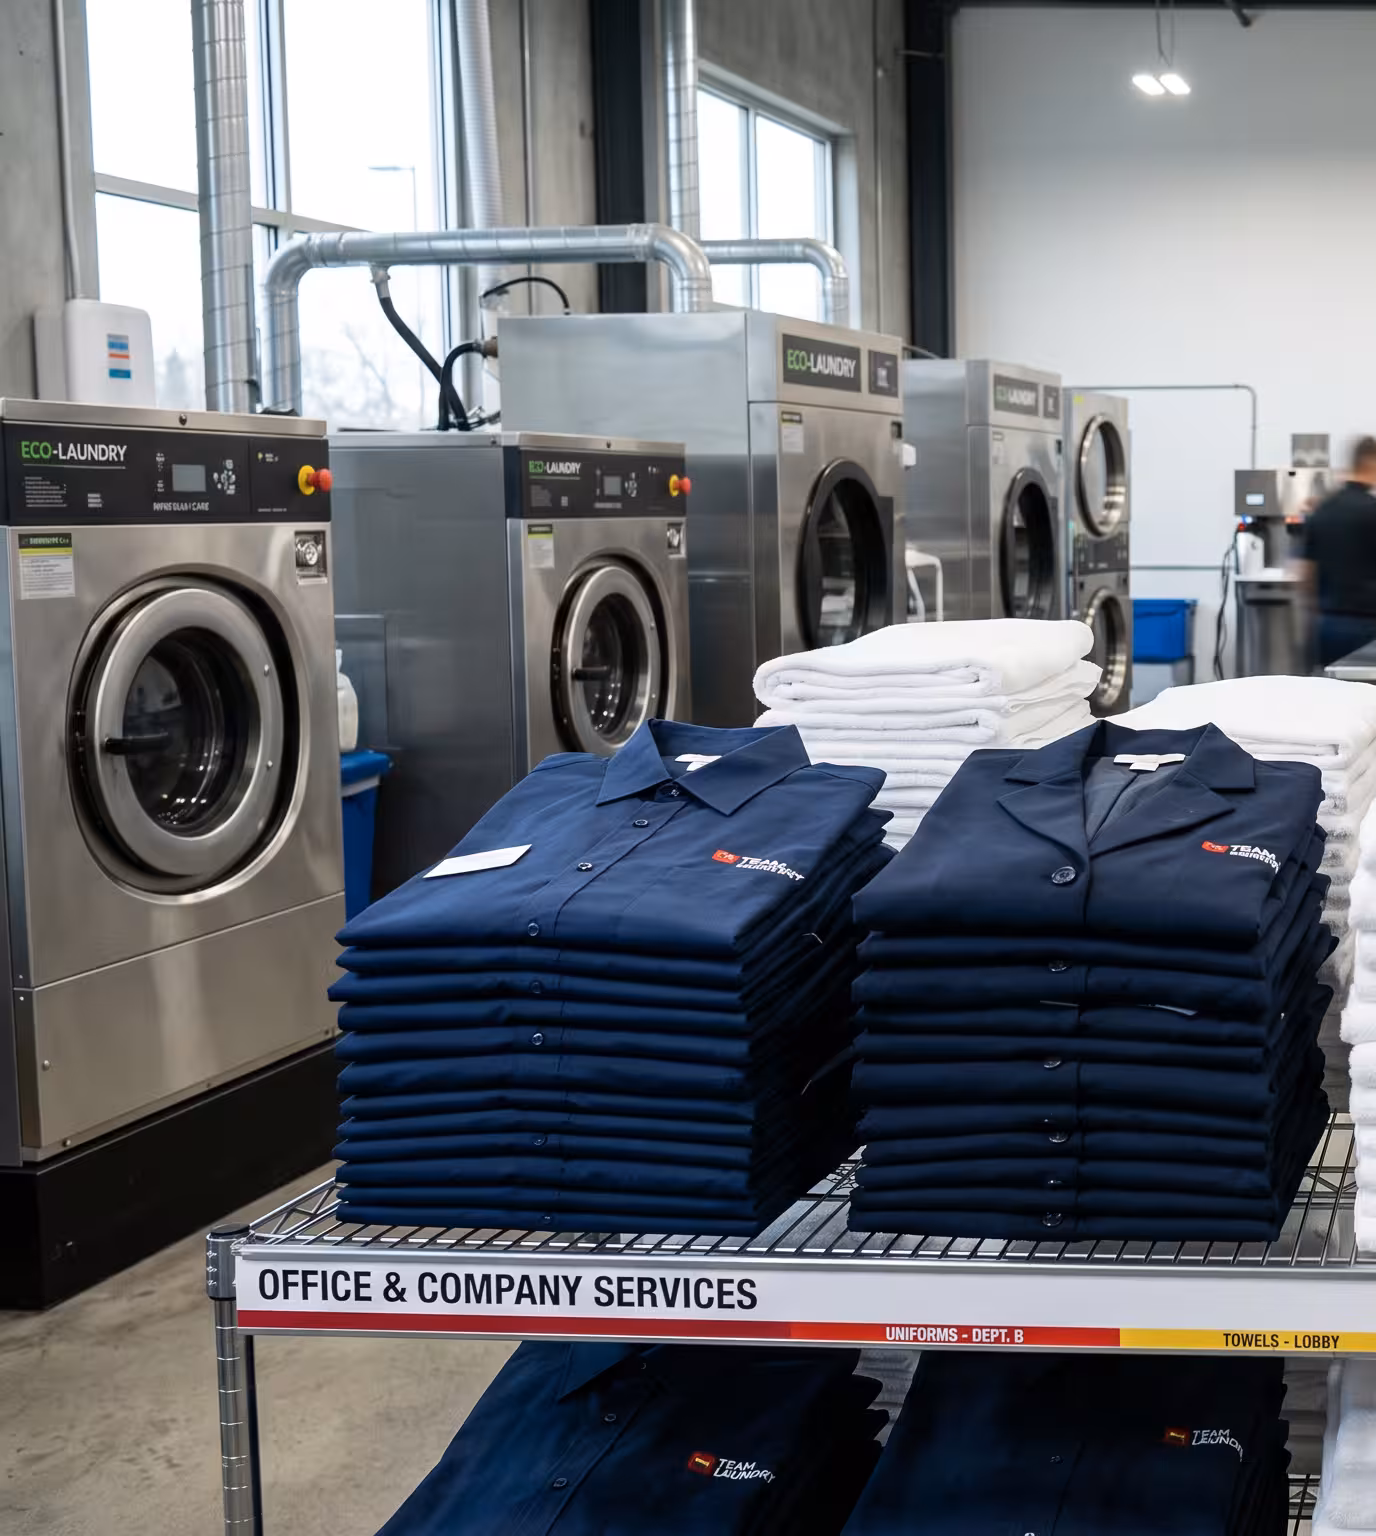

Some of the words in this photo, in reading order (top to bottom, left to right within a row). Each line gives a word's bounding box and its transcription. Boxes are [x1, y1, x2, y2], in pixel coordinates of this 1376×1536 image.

[787, 350, 856, 378] ECO-LAUNDRY
[21, 441, 127, 462] ECO-LAUNDRY
[258, 1269, 373, 1302] OFFICE
[382, 1271, 408, 1303] &
[417, 1272, 583, 1306] COMPANY
[594, 1275, 758, 1309] SERVICES
[885, 1326, 958, 1342] UNIFORMS
[972, 1328, 1010, 1343] DEPT.
[1014, 1329, 1024, 1343] B
[1223, 1333, 1279, 1347] TOWELS
[1294, 1335, 1340, 1349] LOBBY
[719, 1458, 756, 1470] TEAM
[713, 1467, 776, 1483] LAUNDRY
